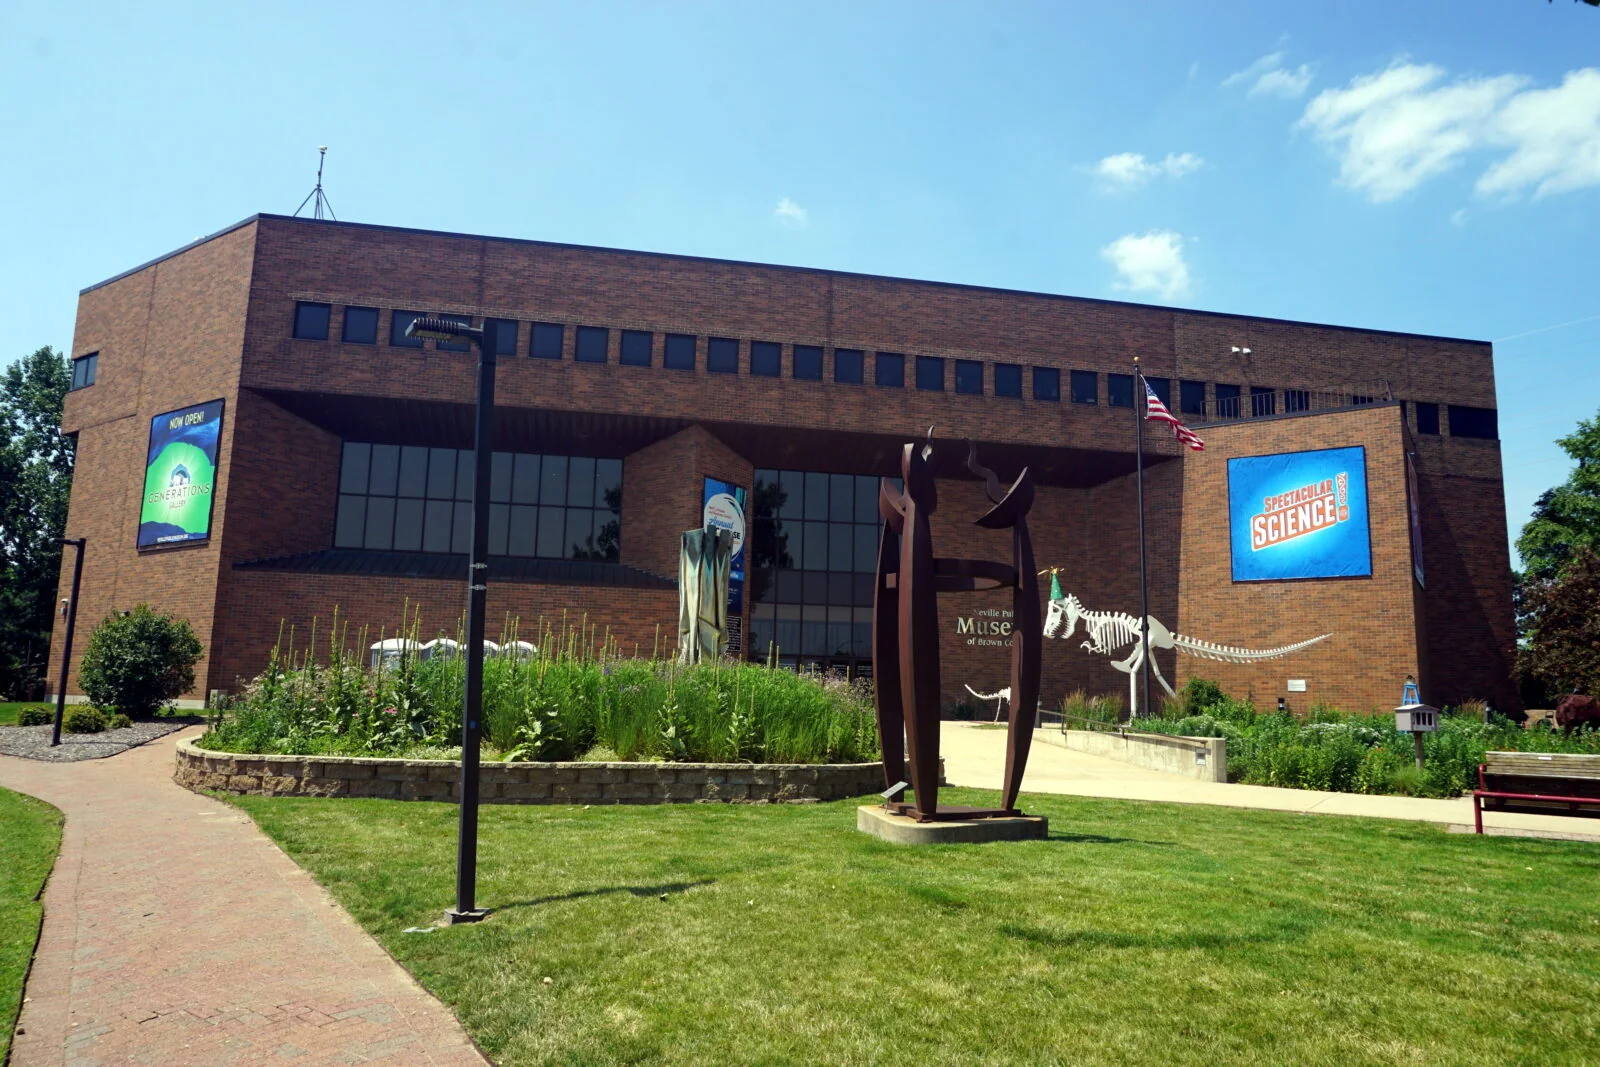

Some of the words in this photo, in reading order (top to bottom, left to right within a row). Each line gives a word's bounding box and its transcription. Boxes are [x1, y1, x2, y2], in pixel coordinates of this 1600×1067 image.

[170, 415, 184, 430] NOW
[184, 411, 205, 426] OPEN!
[149, 483, 210, 503] GENERATIONS
[1264, 479, 1333, 513] SPECTACULAR
[1002, 609, 1014, 618] Pu
[957, 617, 1014, 636] Muse
[967, 637, 976, 645] of
[978, 638, 1003, 647] Brown
[1004, 639, 1014, 647] Co
